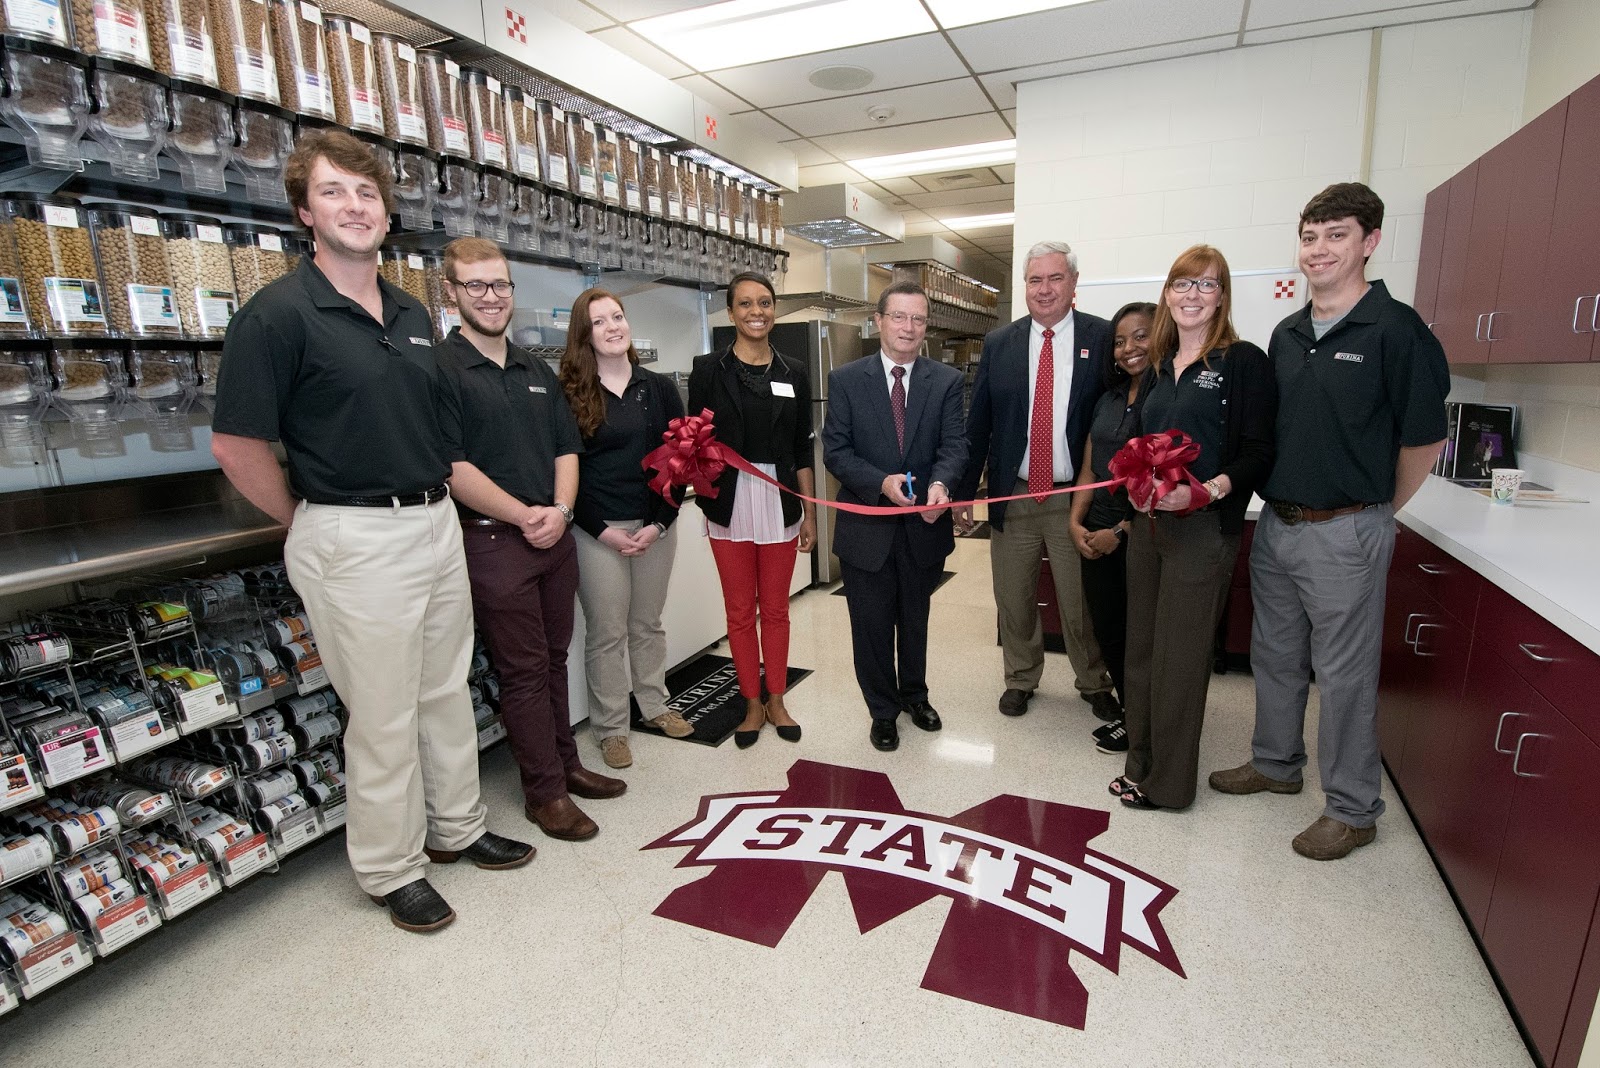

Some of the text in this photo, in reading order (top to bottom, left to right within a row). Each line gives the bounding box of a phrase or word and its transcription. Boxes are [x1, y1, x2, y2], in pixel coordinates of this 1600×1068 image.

[243, 680, 258, 690] CN
[667, 668, 737, 711] PURINA
[715, 689, 740, 702] Our
[46, 742, 60, 752] UR
[743, 813, 1074, 924] STATE
